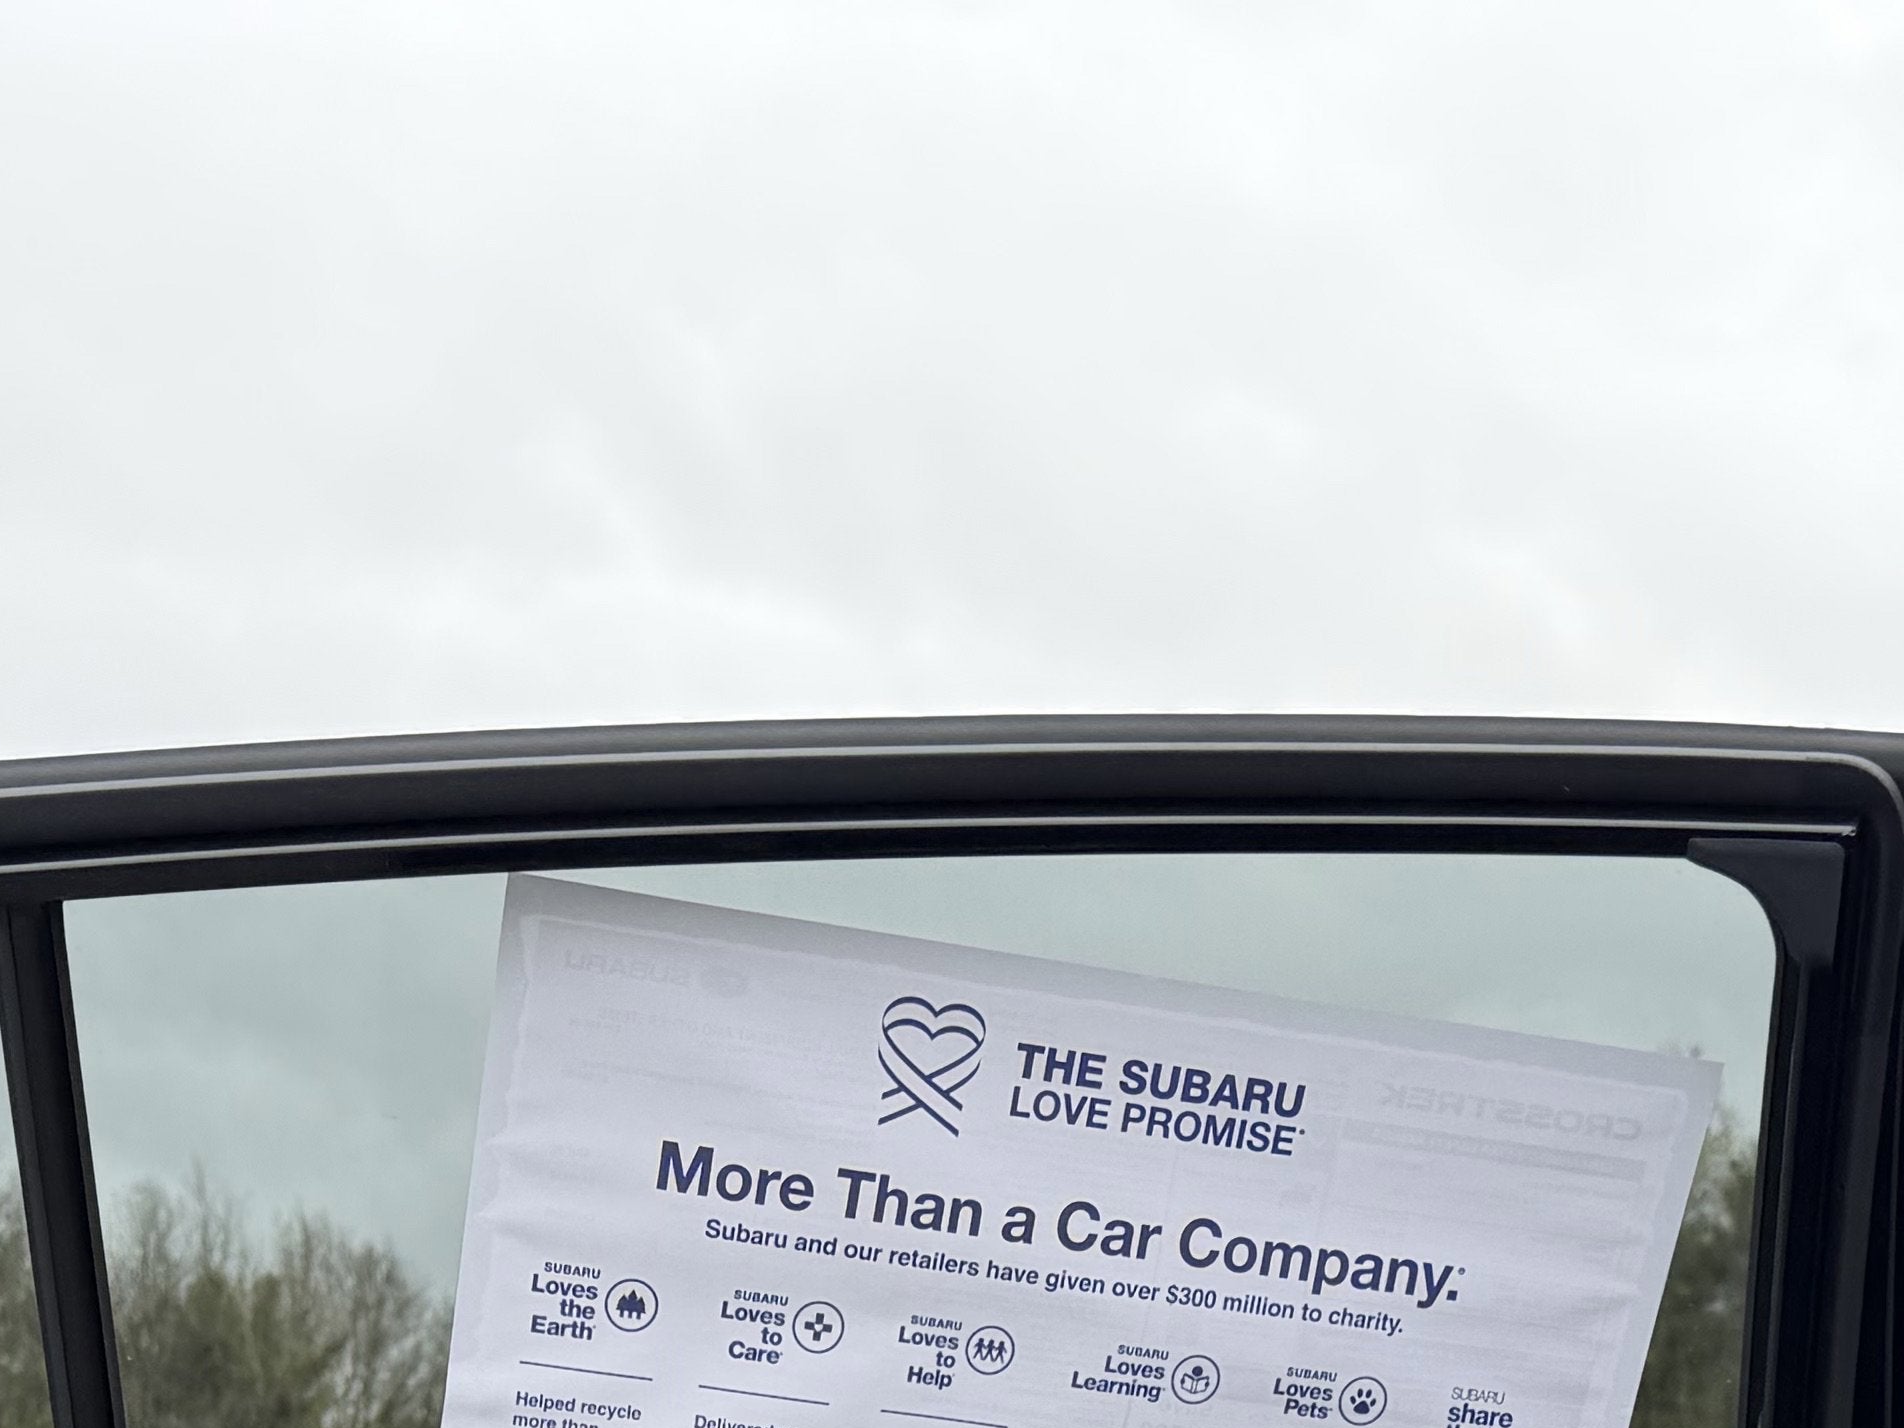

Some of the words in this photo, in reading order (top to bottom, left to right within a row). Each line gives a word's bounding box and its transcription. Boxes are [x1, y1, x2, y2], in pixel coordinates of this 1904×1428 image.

[1017, 1042, 1107, 1090] THE
[1119, 1059, 1306, 1118] SUBARU
[1010, 1086, 1112, 1130] LOVE
[656, 1140, 814, 1211] More
[837, 1168, 982, 1237] Than
[1001, 1206, 1036, 1245] a
[1057, 1201, 1163, 1260] Car
[544, 1262, 601, 1279] SUBARU
[705, 1219, 787, 1248] Subaru
[794, 1237, 838, 1256] and
[844, 1244, 883, 1262] our
[888, 1250, 979, 1276] retailers
[986, 1260, 1039, 1284] have
[1044, 1270, 1105, 1294] given
[1112, 1282, 1160, 1301] over
[1166, 1284, 1217, 1309] $300
[1223, 1295, 1294, 1319] million
[1302, 1303, 1322, 1322] to
[1328, 1307, 1402, 1337] charity.
[531, 1273, 598, 1300] Loves
[734, 1290, 789, 1306] SUBARU
[559, 1299, 595, 1320] the
[721, 1301, 785, 1326] Loves
[531, 1314, 593, 1340] Earth
[911, 1315, 962, 1331] SUBARU
[761, 1327, 782, 1346] to
[898, 1326, 959, 1350] Loves
[729, 1340, 780, 1364] Care
[936, 1351, 956, 1368] to
[1117, 1345, 1169, 1360] SUBARU
[907, 1365, 952, 1390] Help
[1104, 1355, 1165, 1380] Loves
[1287, 1367, 1337, 1382] SUBARU
[1071, 1371, 1162, 1403] Learning
[1273, 1377, 1333, 1401] Loves
[1452, 1387, 1505, 1405] SUBARU
[516, 1391, 576, 1412] Helped
[581, 1402, 641, 1421] recycle
[1284, 1398, 1329, 1419] Pets
[1447, 1403, 1513, 1428] share
